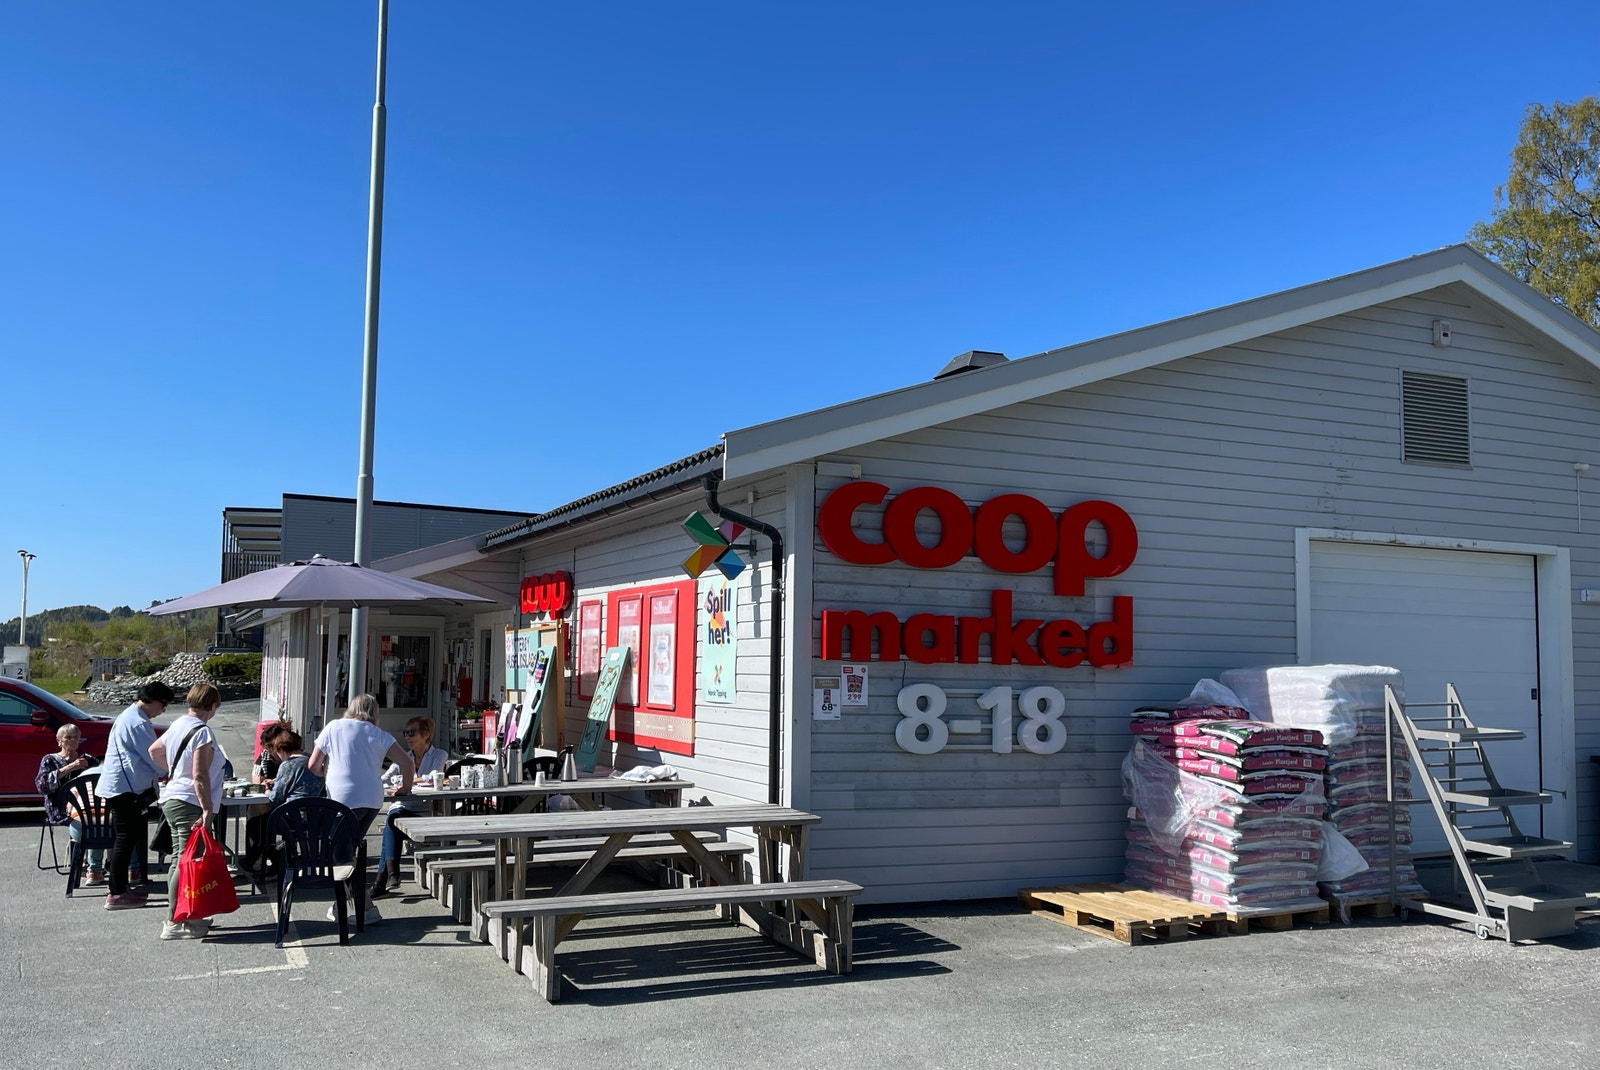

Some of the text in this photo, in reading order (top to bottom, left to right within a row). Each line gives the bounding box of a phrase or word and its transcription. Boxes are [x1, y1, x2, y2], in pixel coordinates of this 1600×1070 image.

[818, 481, 1138, 596] coop
[706, 588, 731, 619] Spill
[821, 589, 1133, 668] marked
[708, 620, 731, 645] her!
[17, 667, 24, 675] 2
[895, 683, 1067, 755] 8-18
